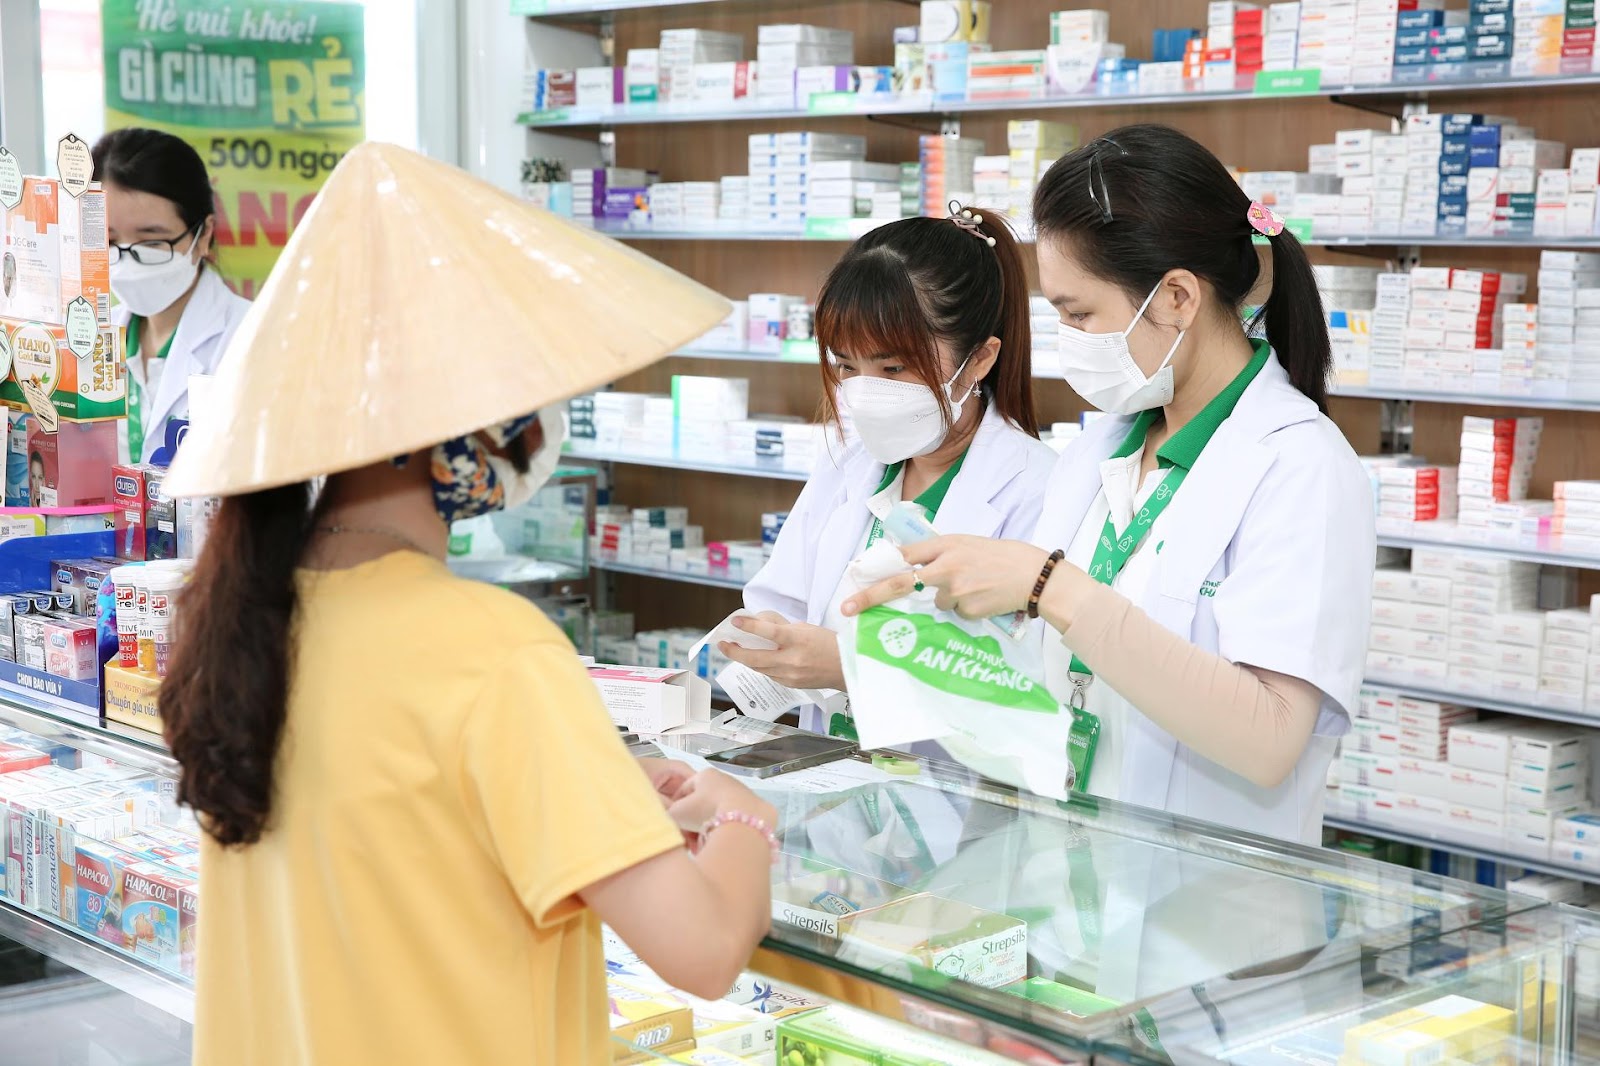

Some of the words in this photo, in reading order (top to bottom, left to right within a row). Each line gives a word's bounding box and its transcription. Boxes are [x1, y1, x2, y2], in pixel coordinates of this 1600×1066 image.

[135, 2, 176, 33] Hè
[184, 7, 232, 37] vui
[239, 10, 317, 44] khỏe!
[119, 40, 156, 102] GÌ
[161, 43, 257, 107] CŨNG
[269, 37, 358, 125] RẺ
[209, 138, 273, 168] 500
[279, 143, 345, 180] ngà
[18, 337, 50, 354] NANO
[18, 351, 33, 361] Gold
[93, 333, 105, 392] NANO
[106, 364, 114, 391] Gold
[116, 478, 137, 496] durex
[17, 672, 33, 688] CHỌN
[33, 677, 45, 691] BAO
[912, 646, 956, 672] AN
[951, 656, 1033, 692] KHANG
[49, 834, 58, 912] EFFERALGAN
[77, 864, 109, 888] HAPACOL
[125, 873, 167, 902] HAPACOL
[783, 908, 834, 935] Strepsils
[981, 928, 1026, 956] Strepsils
